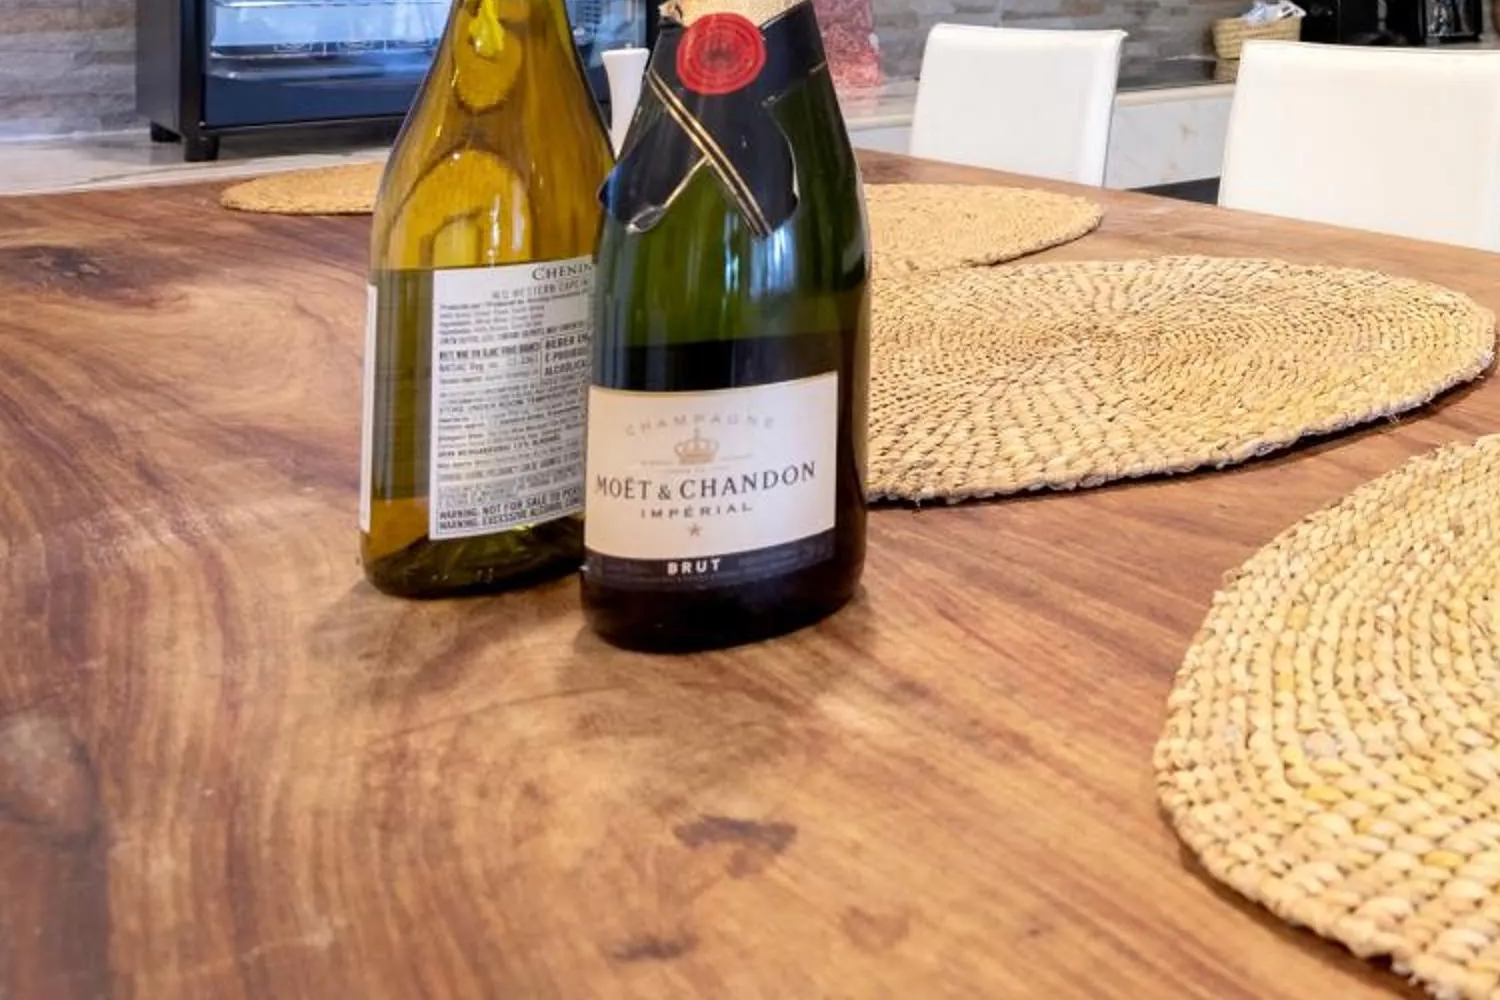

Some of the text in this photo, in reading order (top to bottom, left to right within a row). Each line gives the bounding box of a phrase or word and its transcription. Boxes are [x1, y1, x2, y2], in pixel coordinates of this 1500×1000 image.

[625, 413, 775, 436] CHAMPAGNE
[658, 483, 672, 501] &
[680, 461, 816, 500] CHANDON
[667, 558, 722, 576] BRUT
